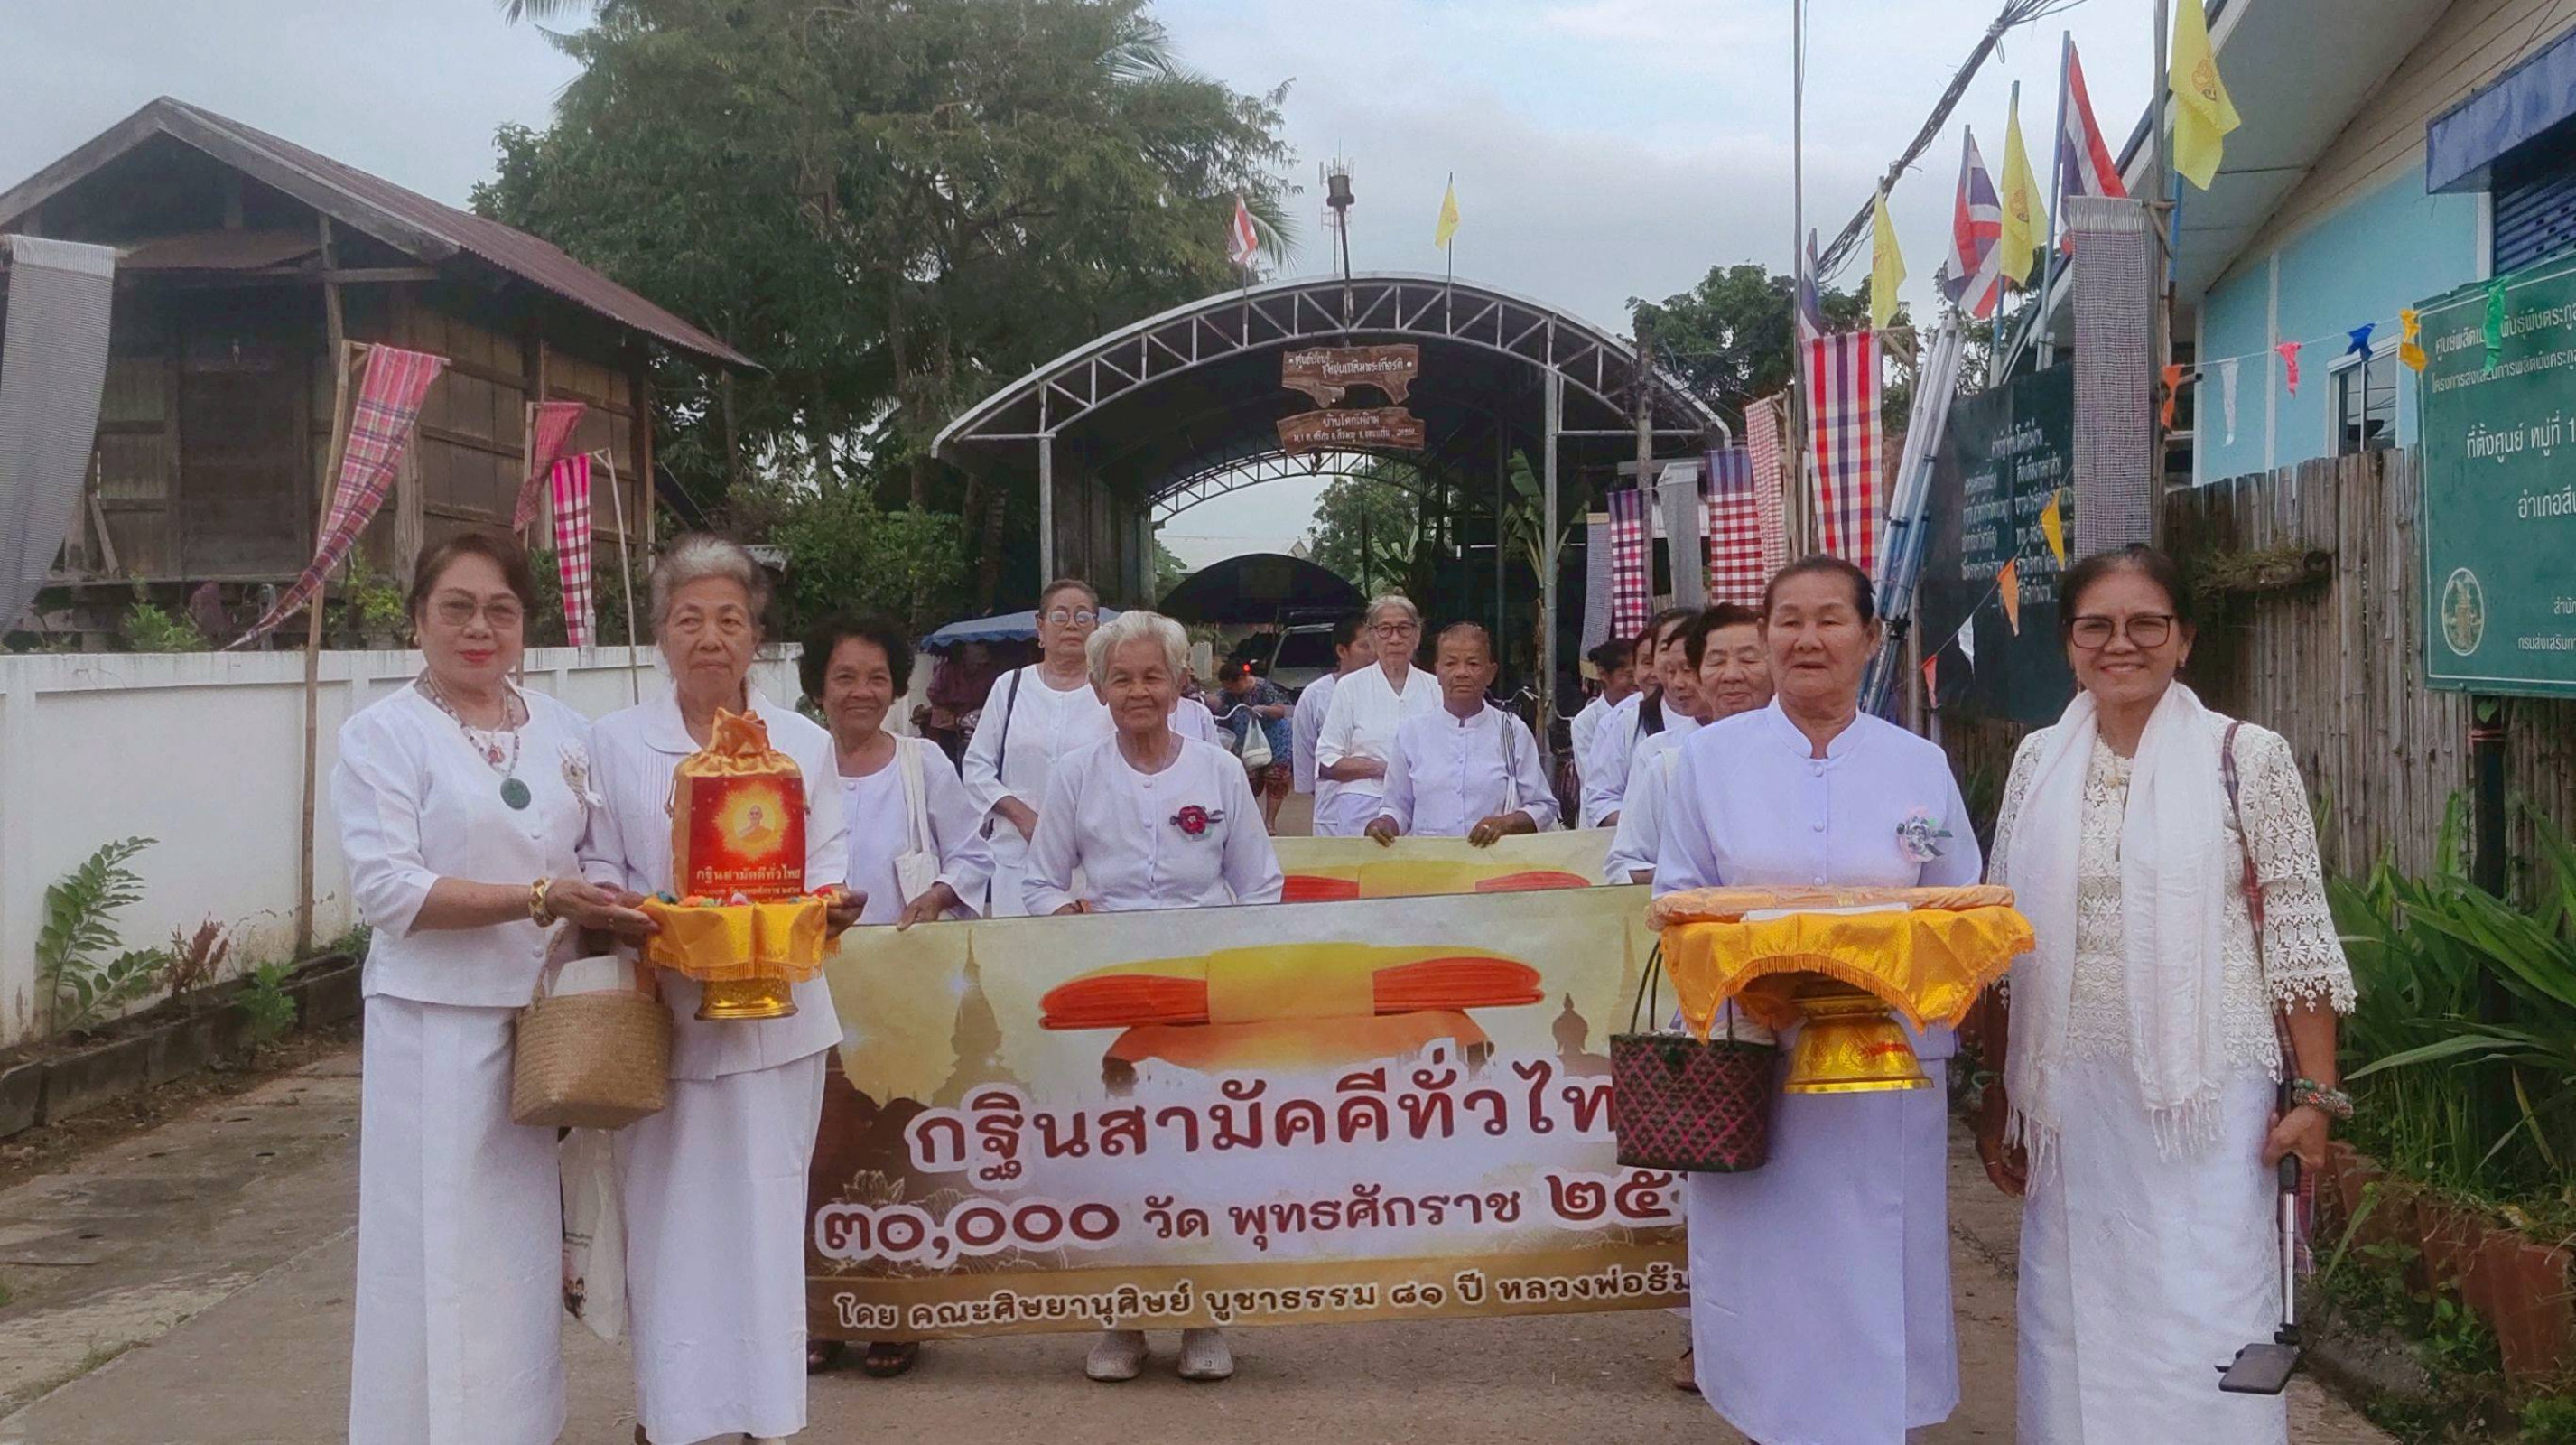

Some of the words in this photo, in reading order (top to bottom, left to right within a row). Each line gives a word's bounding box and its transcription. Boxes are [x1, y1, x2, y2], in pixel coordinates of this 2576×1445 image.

[2467, 422, 2524, 463] ที่ตั้งศูนย์
[2531, 409, 2560, 456] หมู่ที่
[916, 1047, 1615, 1180] กฐินสามัคคีทั่วไท
[824, 1203, 1120, 1259] ๓๐,๐๐๐
[1143, 1195, 1210, 1238] วัด
[1228, 1183, 1521, 1252] พุทธศักราช
[1544, 1171, 1687, 1221] ๒๕
[838, 1296, 896, 1325] โดย
[912, 1282, 1191, 1325] คณะศิษยานุศิษย์
[1206, 1283, 1375, 1321] บูชาธรรม
[1392, 1283, 1443, 1304] ๘๑
[1458, 1272, 1483, 1300] ปี
